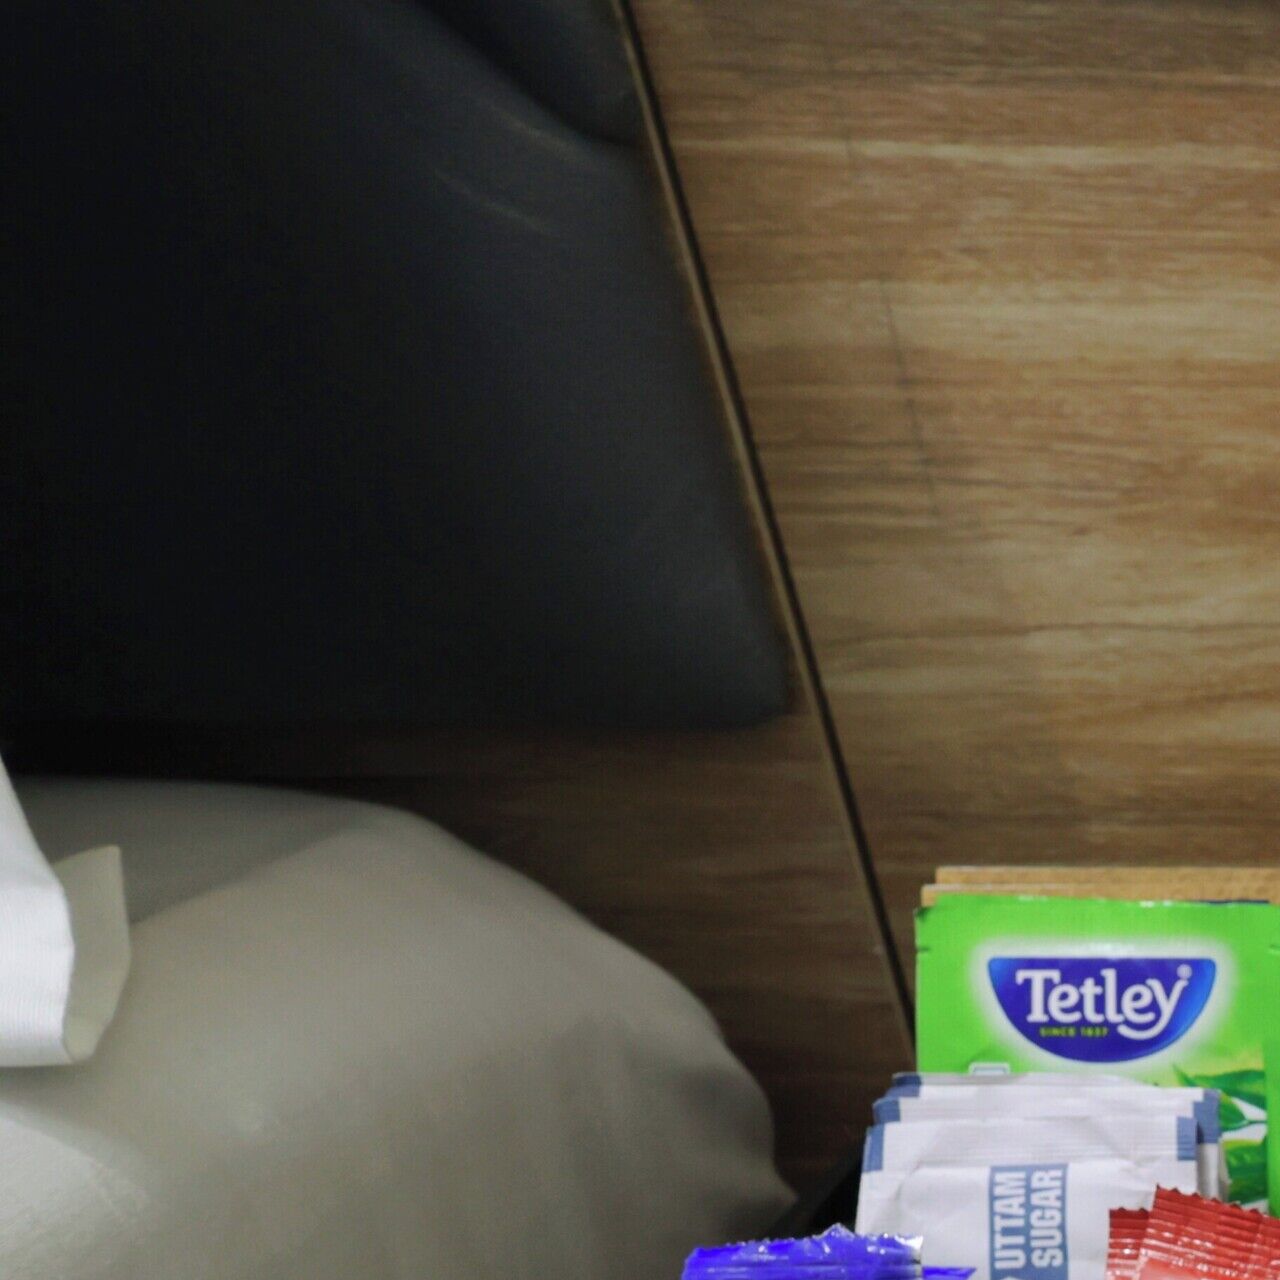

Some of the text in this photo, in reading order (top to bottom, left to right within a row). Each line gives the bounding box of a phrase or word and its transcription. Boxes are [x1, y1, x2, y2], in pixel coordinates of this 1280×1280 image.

[1015, 967, 1190, 1040] Tetley
[1039, 1027, 1076, 1038] SINCE
[993, 1170, 1027, 1270] UTTAM
[1030, 1168, 1064, 1268] SUGAR
